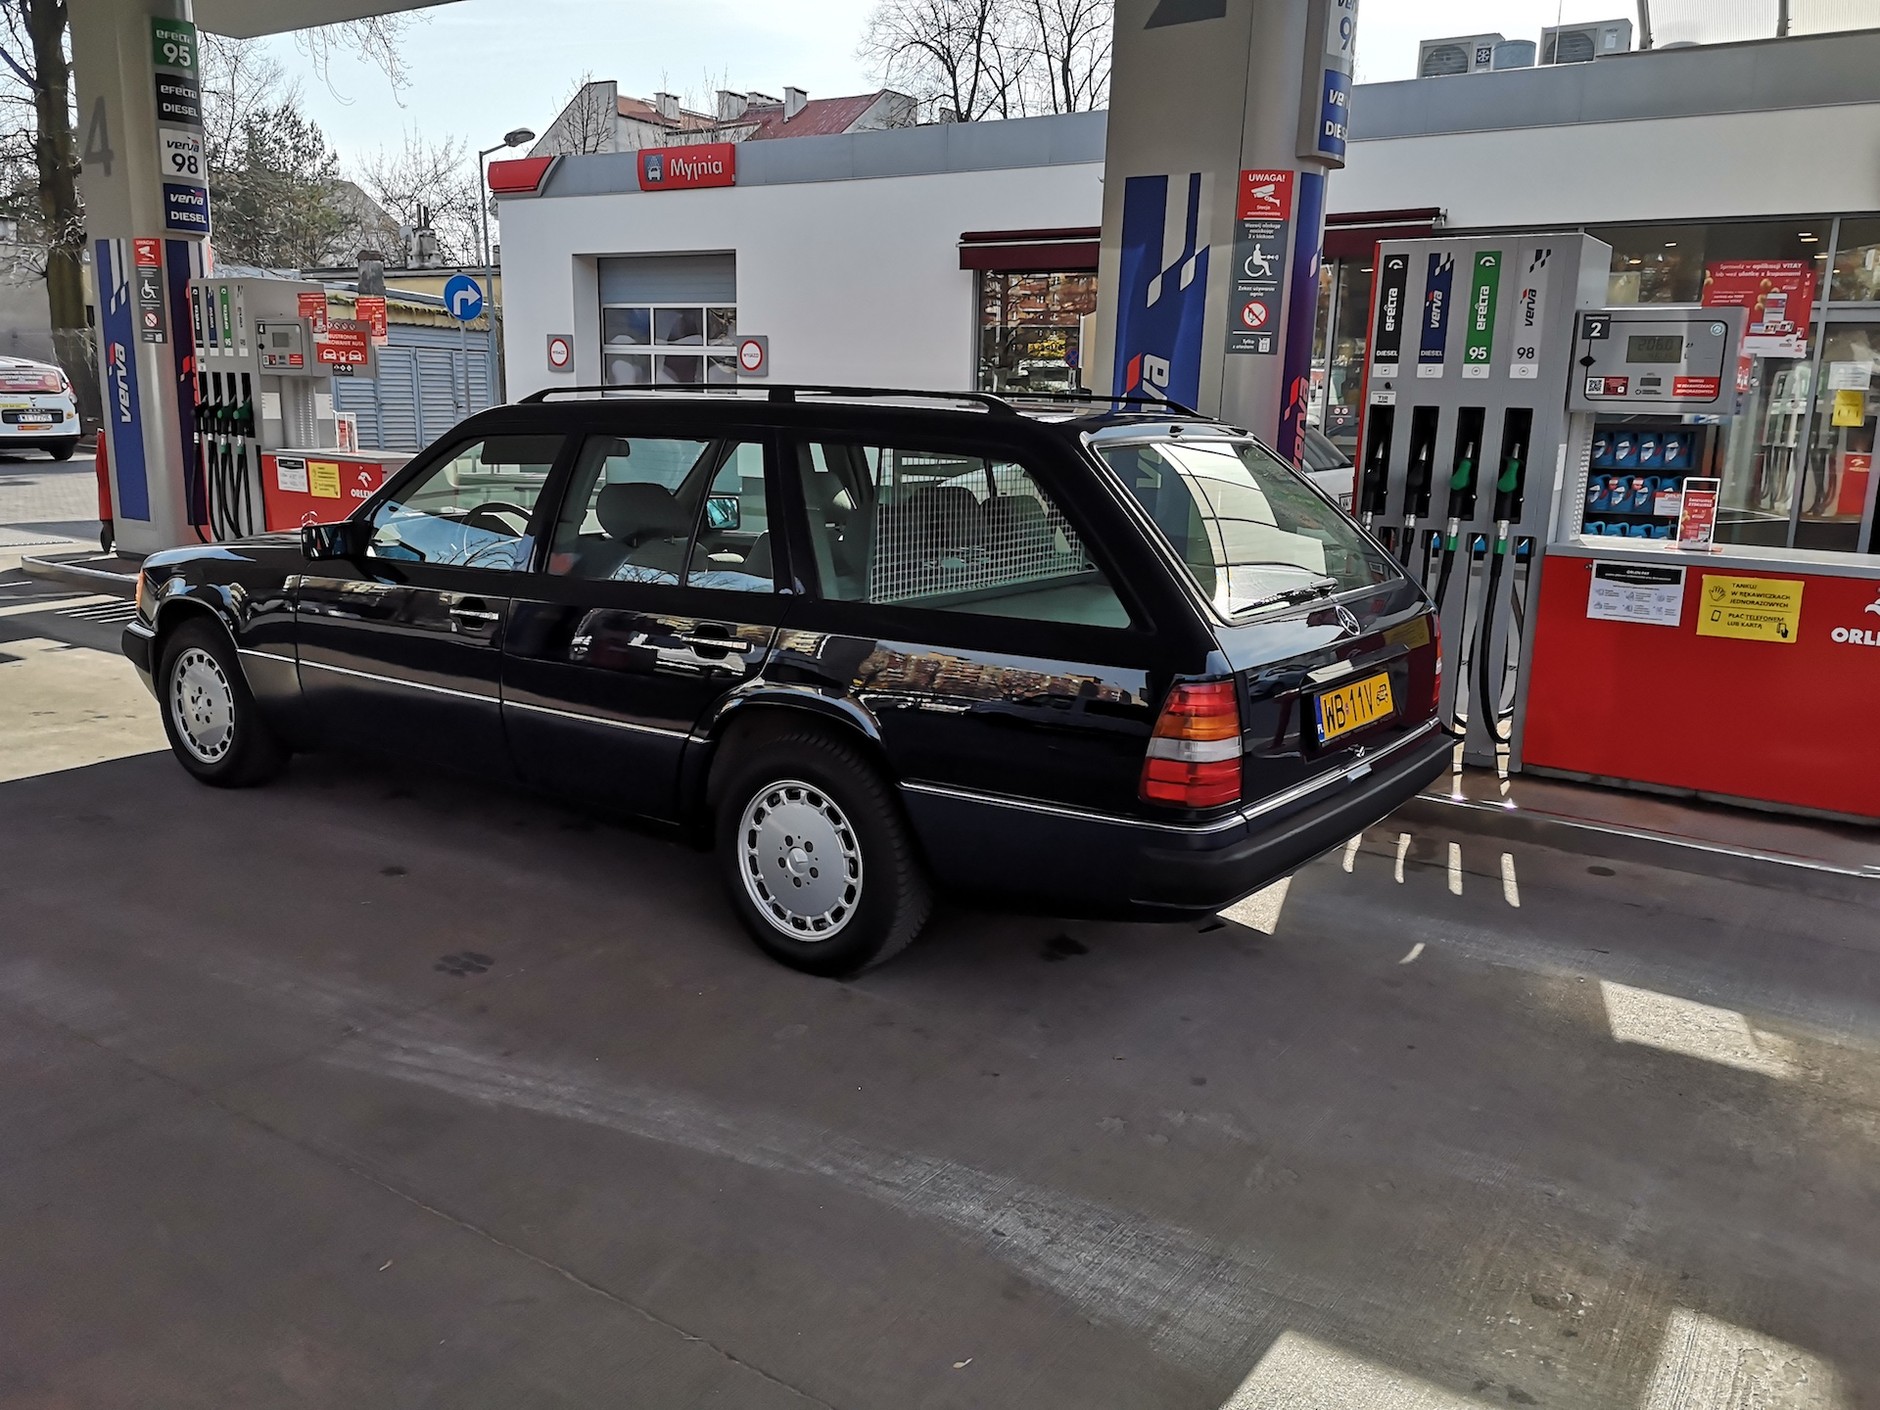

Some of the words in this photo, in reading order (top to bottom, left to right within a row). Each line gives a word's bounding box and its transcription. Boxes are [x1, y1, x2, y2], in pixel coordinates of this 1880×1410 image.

[156, 28, 193, 44] efecta
[163, 43, 192, 67] 95
[160, 84, 197, 99] efecta
[163, 102, 198, 118] DIESEL
[84, 96, 114, 177] 4
[166, 139, 200, 153] verva
[171, 153, 198, 175] 98
[670, 155, 723, 181] Myjnia
[1248, 173, 1286, 182] UWAGA!
[170, 192, 203, 206] verva
[170, 209, 206, 225] DIESEL
[1384, 288, 1398, 331] efecta
[1430, 290, 1443, 328] verva
[1475, 286, 1490, 331] efecta
[1524, 288, 1537, 327] verva
[1590, 321, 1602, 337] 2
[1469, 346, 1487, 360] 95
[1517, 346, 1535, 360] 98
[115, 342, 132, 423] verva
[1729, 599, 1788, 608] JEDNORAZOWYCH
[1324, 693, 1346, 733] WB
[1349, 682, 1374, 723] 11V
